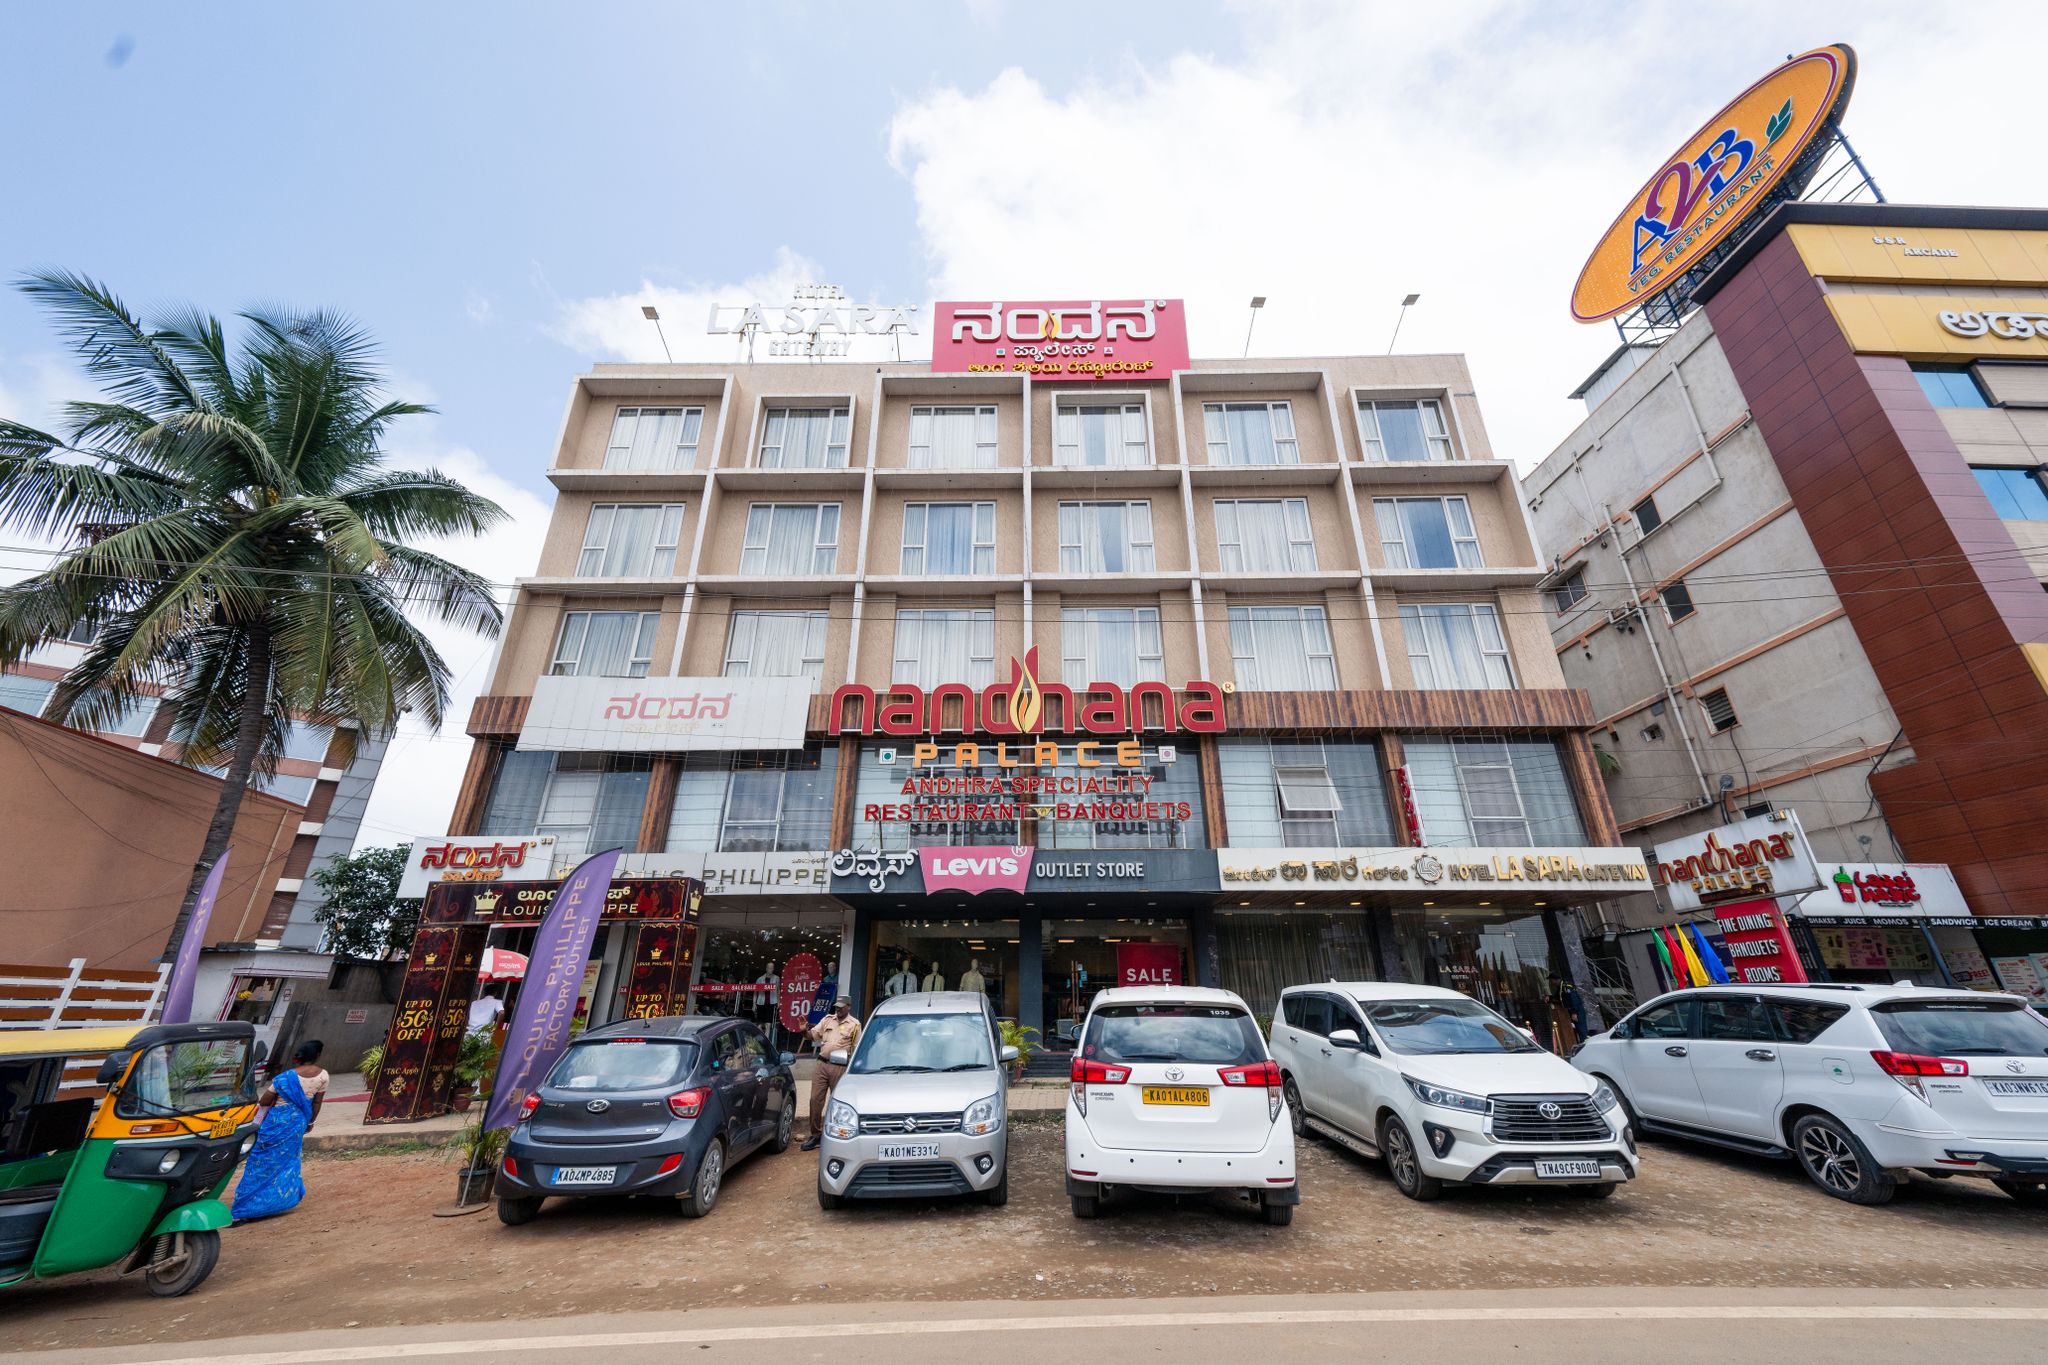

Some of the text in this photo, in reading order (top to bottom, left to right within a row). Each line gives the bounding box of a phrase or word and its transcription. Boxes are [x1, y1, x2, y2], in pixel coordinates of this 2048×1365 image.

[1629, 127, 1756, 276] A2B
[1628, 157, 1774, 293] VEG. RESTAURANT
[1904, 247, 1959, 257] ARCADE
[794, 284, 844, 299] HOTEL
[707, 302, 919, 335] LA SARA
[952, 300, 1156, 341] ನಂದನ
[768, 340, 852, 356] GATEWAY
[828, 645, 1227, 735] nandhana
[604, 692, 734, 719] ನಂದನ
[914, 741, 1142, 768] PALACE
[901, 775, 1155, 795] ANDHRA SPECIALITY
[864, 802, 1193, 821] RESTAURANT BANQUETS
[420, 842, 529, 869] ನಂದನ
[1658, 832, 1794, 885] nandhana
[831, 847, 918, 893] ಲಿವೈಸ್
[1036, 862, 1145, 878] OUTLET STORE
[1449, 864, 1495, 880] HOTEL
[1493, 855, 1523, 880] LA
[1523, 855, 1582, 881] SARA
[702, 869, 828, 885] PHILIPPE
[1691, 866, 1773, 893] PALACE
[601, 903, 639, 913] IPPE
[1717, 919, 1736, 933] FINE
[1737, 913, 1773, 931] DINING
[1843, 917, 1867, 925] JUICE
[1931, 918, 1978, 926] SANDWICH
[2000, 918, 2033, 926] CREAM
[1728, 939, 1780, 958] BANQUETS
[518, 876, 589, 1077] LOUIS PHILIPPE
[1126, 968, 1173, 981] SALE
[1439, 965, 1478, 973] LA SARA
[1744, 966, 1780, 983] ROOMS
[543, 979, 572, 1051] FACTORY
[567, 917, 591, 977] OUTLET
[788, 981, 816, 993] SALE
[405, 1000, 416, 1008] UP
[635, 994, 662, 1002] UP TO
[790, 1000, 811, 1017] 50
[397, 1029, 425, 1040] OFF
[441, 1027, 460, 1038] OFF
[1149, 1088, 1208, 1103] KA01AL4806
[884, 1146, 938, 1157] KA01NE3314
[558, 1169, 614, 1181] KA04MP4885
[1542, 1162, 1598, 1174] TN49CF9000
